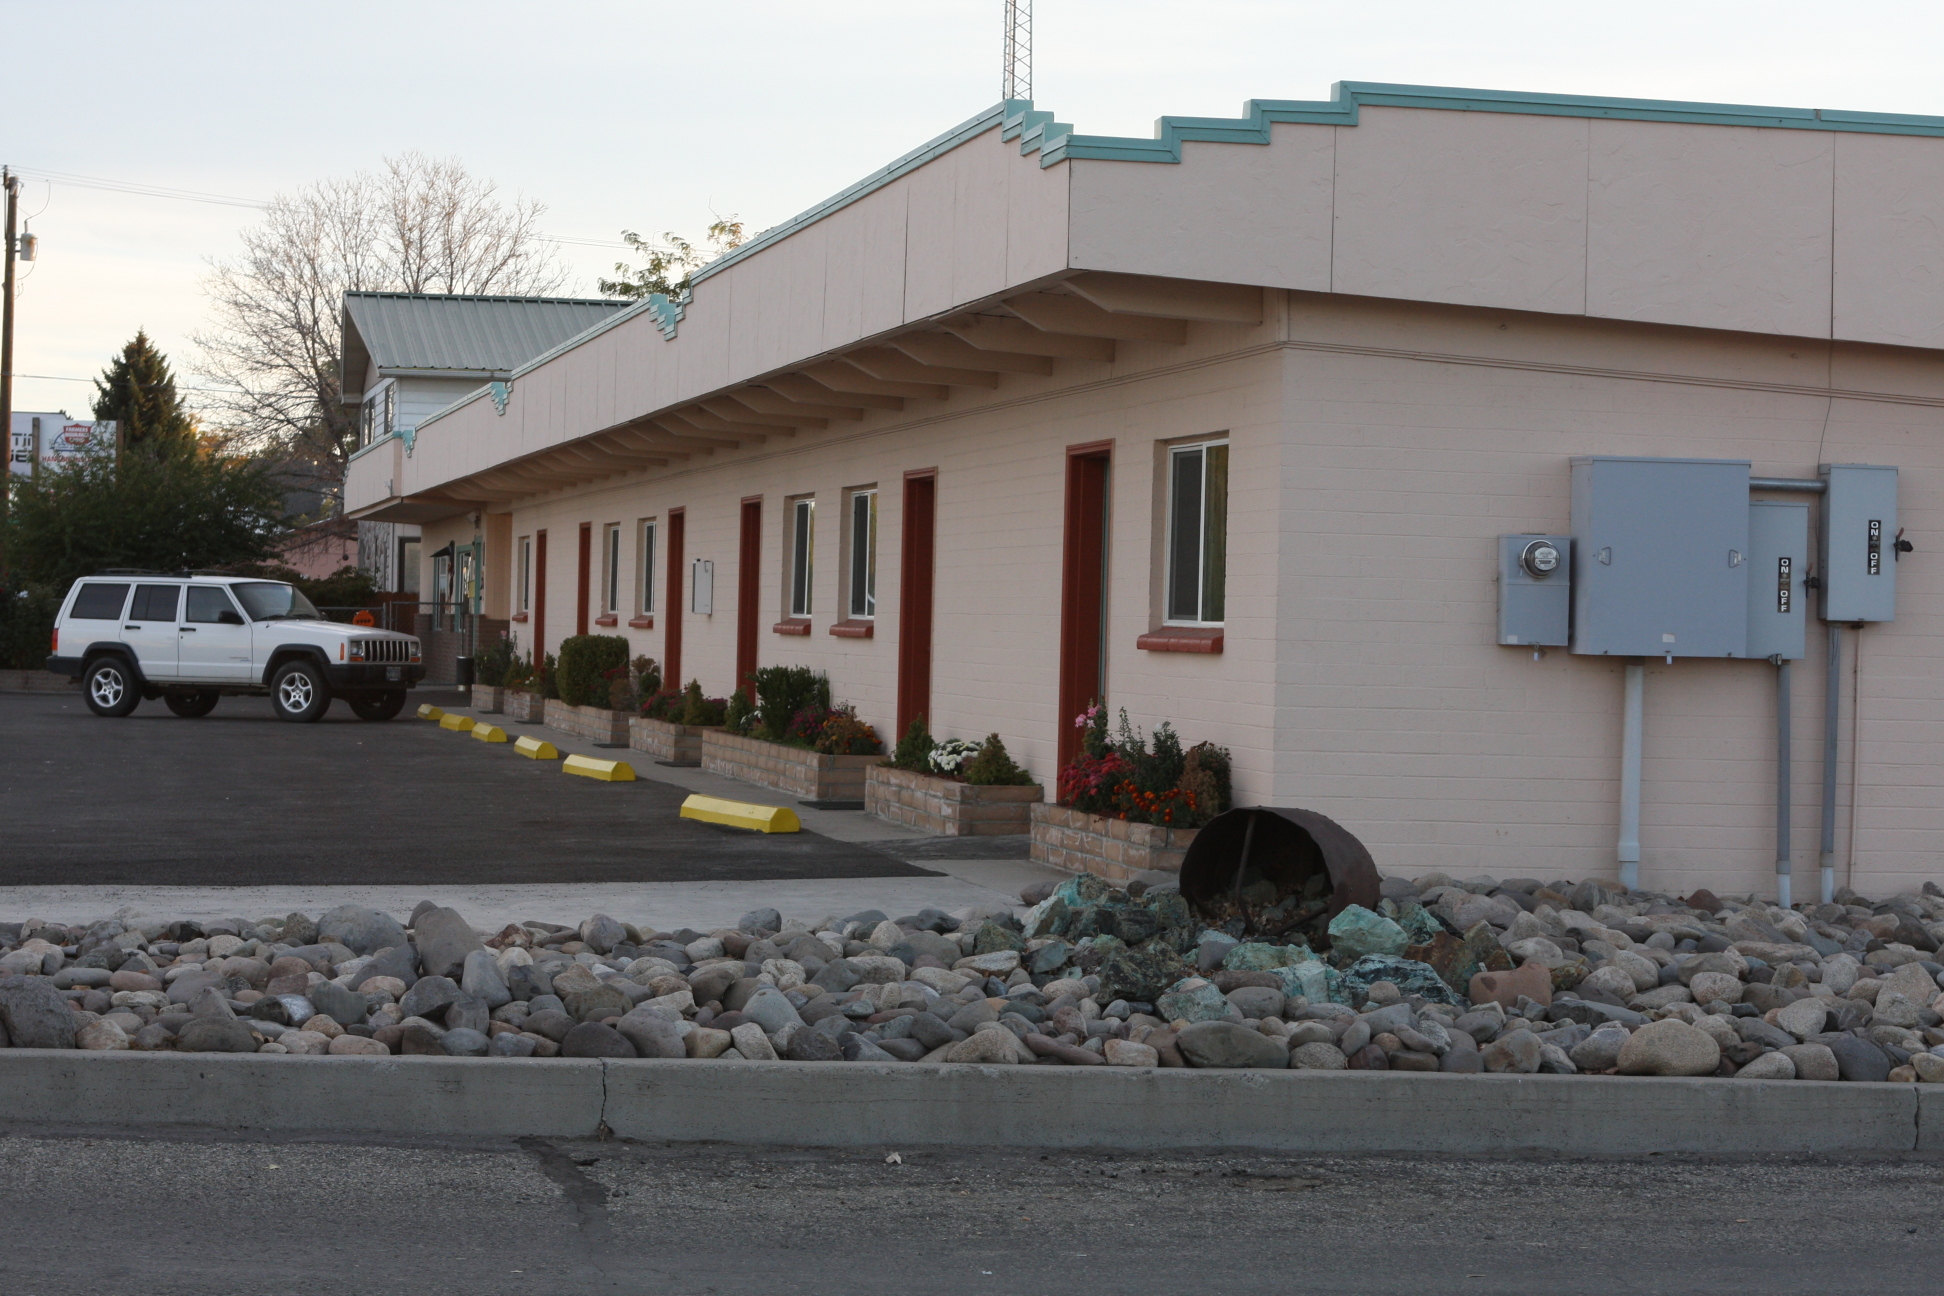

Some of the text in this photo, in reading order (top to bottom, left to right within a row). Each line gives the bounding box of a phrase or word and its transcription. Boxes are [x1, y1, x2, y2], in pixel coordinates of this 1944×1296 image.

[1870, 522, 1879, 535] ON
[1781, 559, 1789, 573] ON
[1870, 553, 1878, 574] OFF
[1780, 591, 1788, 611] OFF
